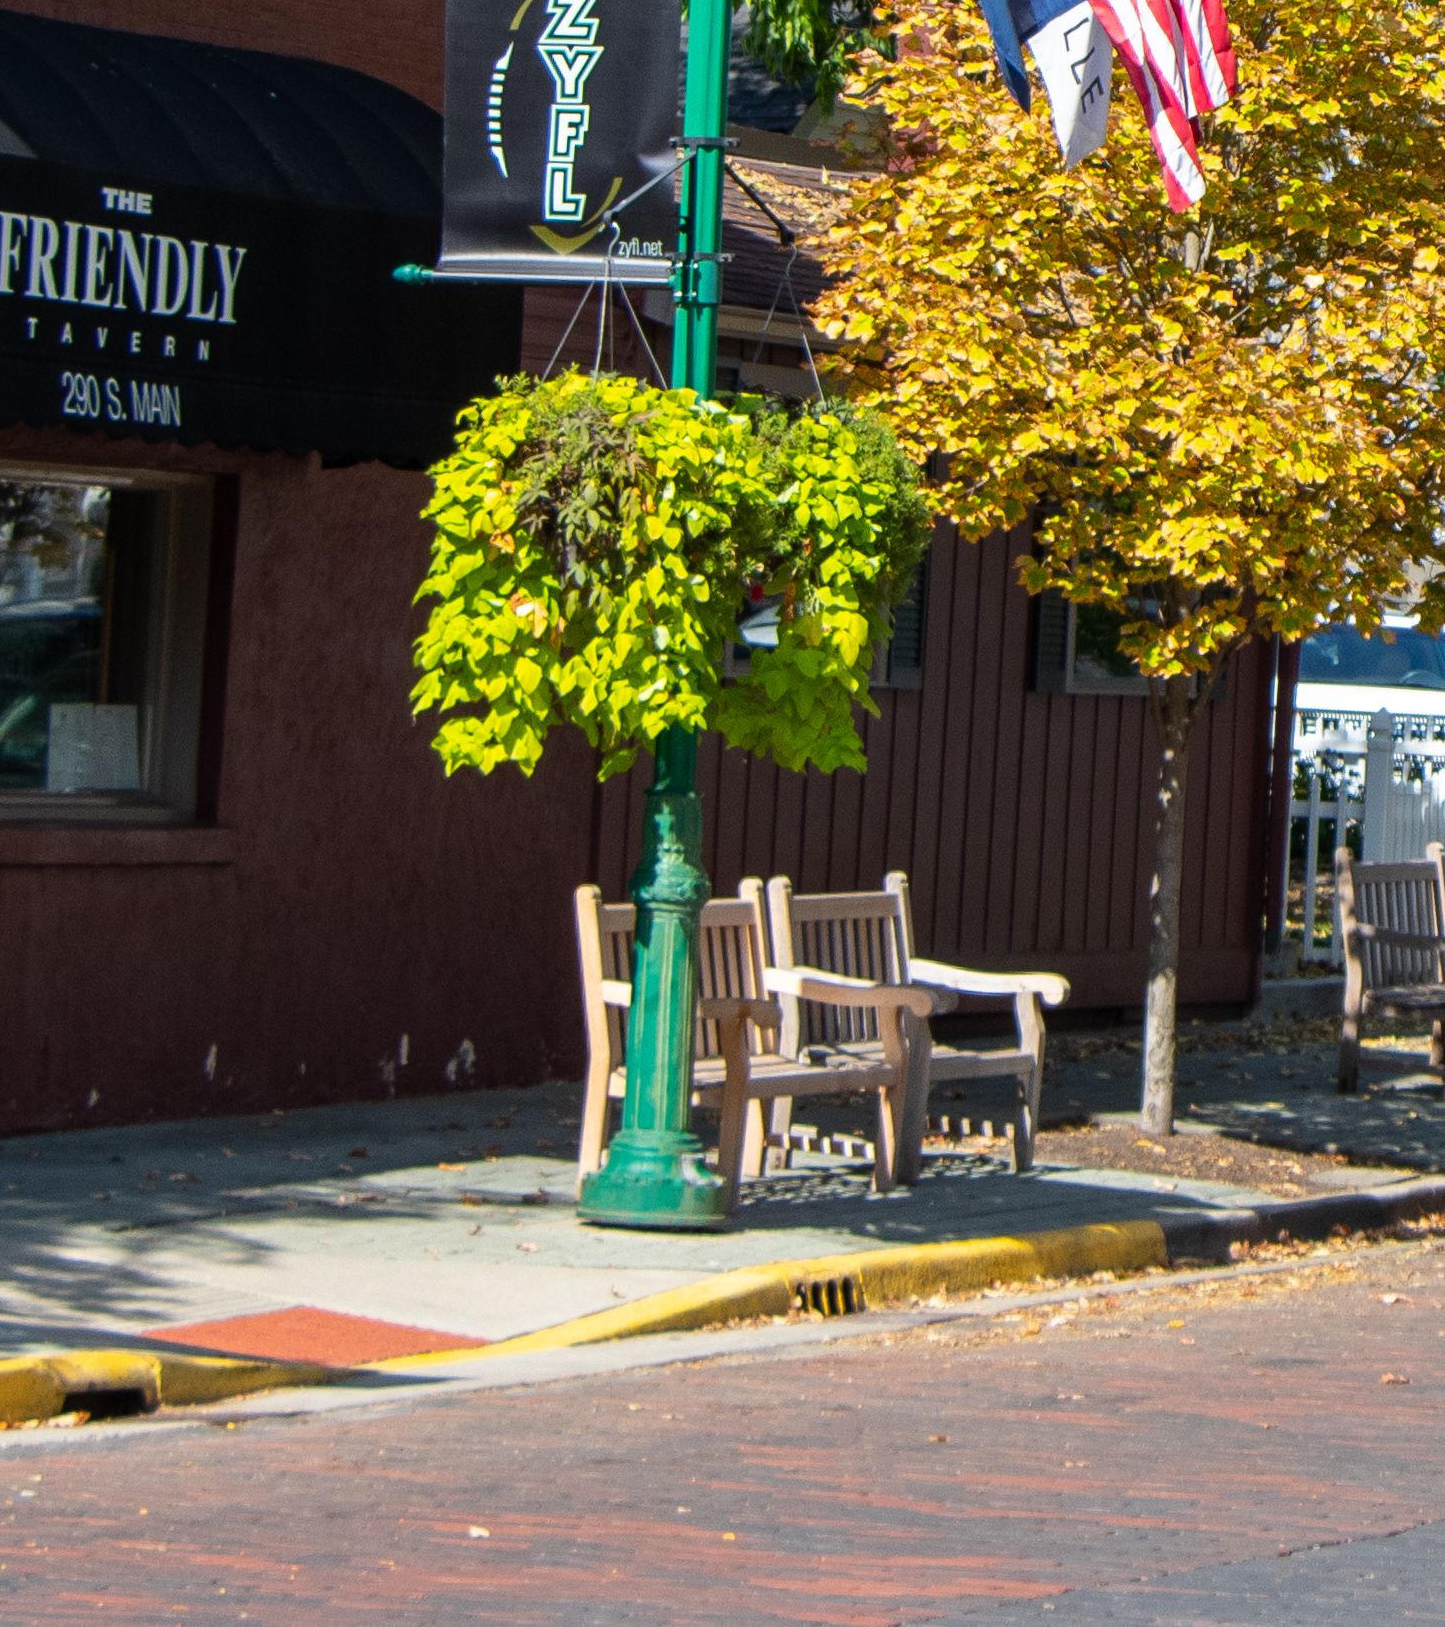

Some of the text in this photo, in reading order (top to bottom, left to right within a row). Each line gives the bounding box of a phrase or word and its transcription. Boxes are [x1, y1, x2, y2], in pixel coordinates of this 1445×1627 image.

[102, 187, 153, 215] THE
[618, 237, 663, 259] zyfl.net
[27, 318, 211, 361] TAVERN
[62, 372, 181, 427] 290 S. MAIN
